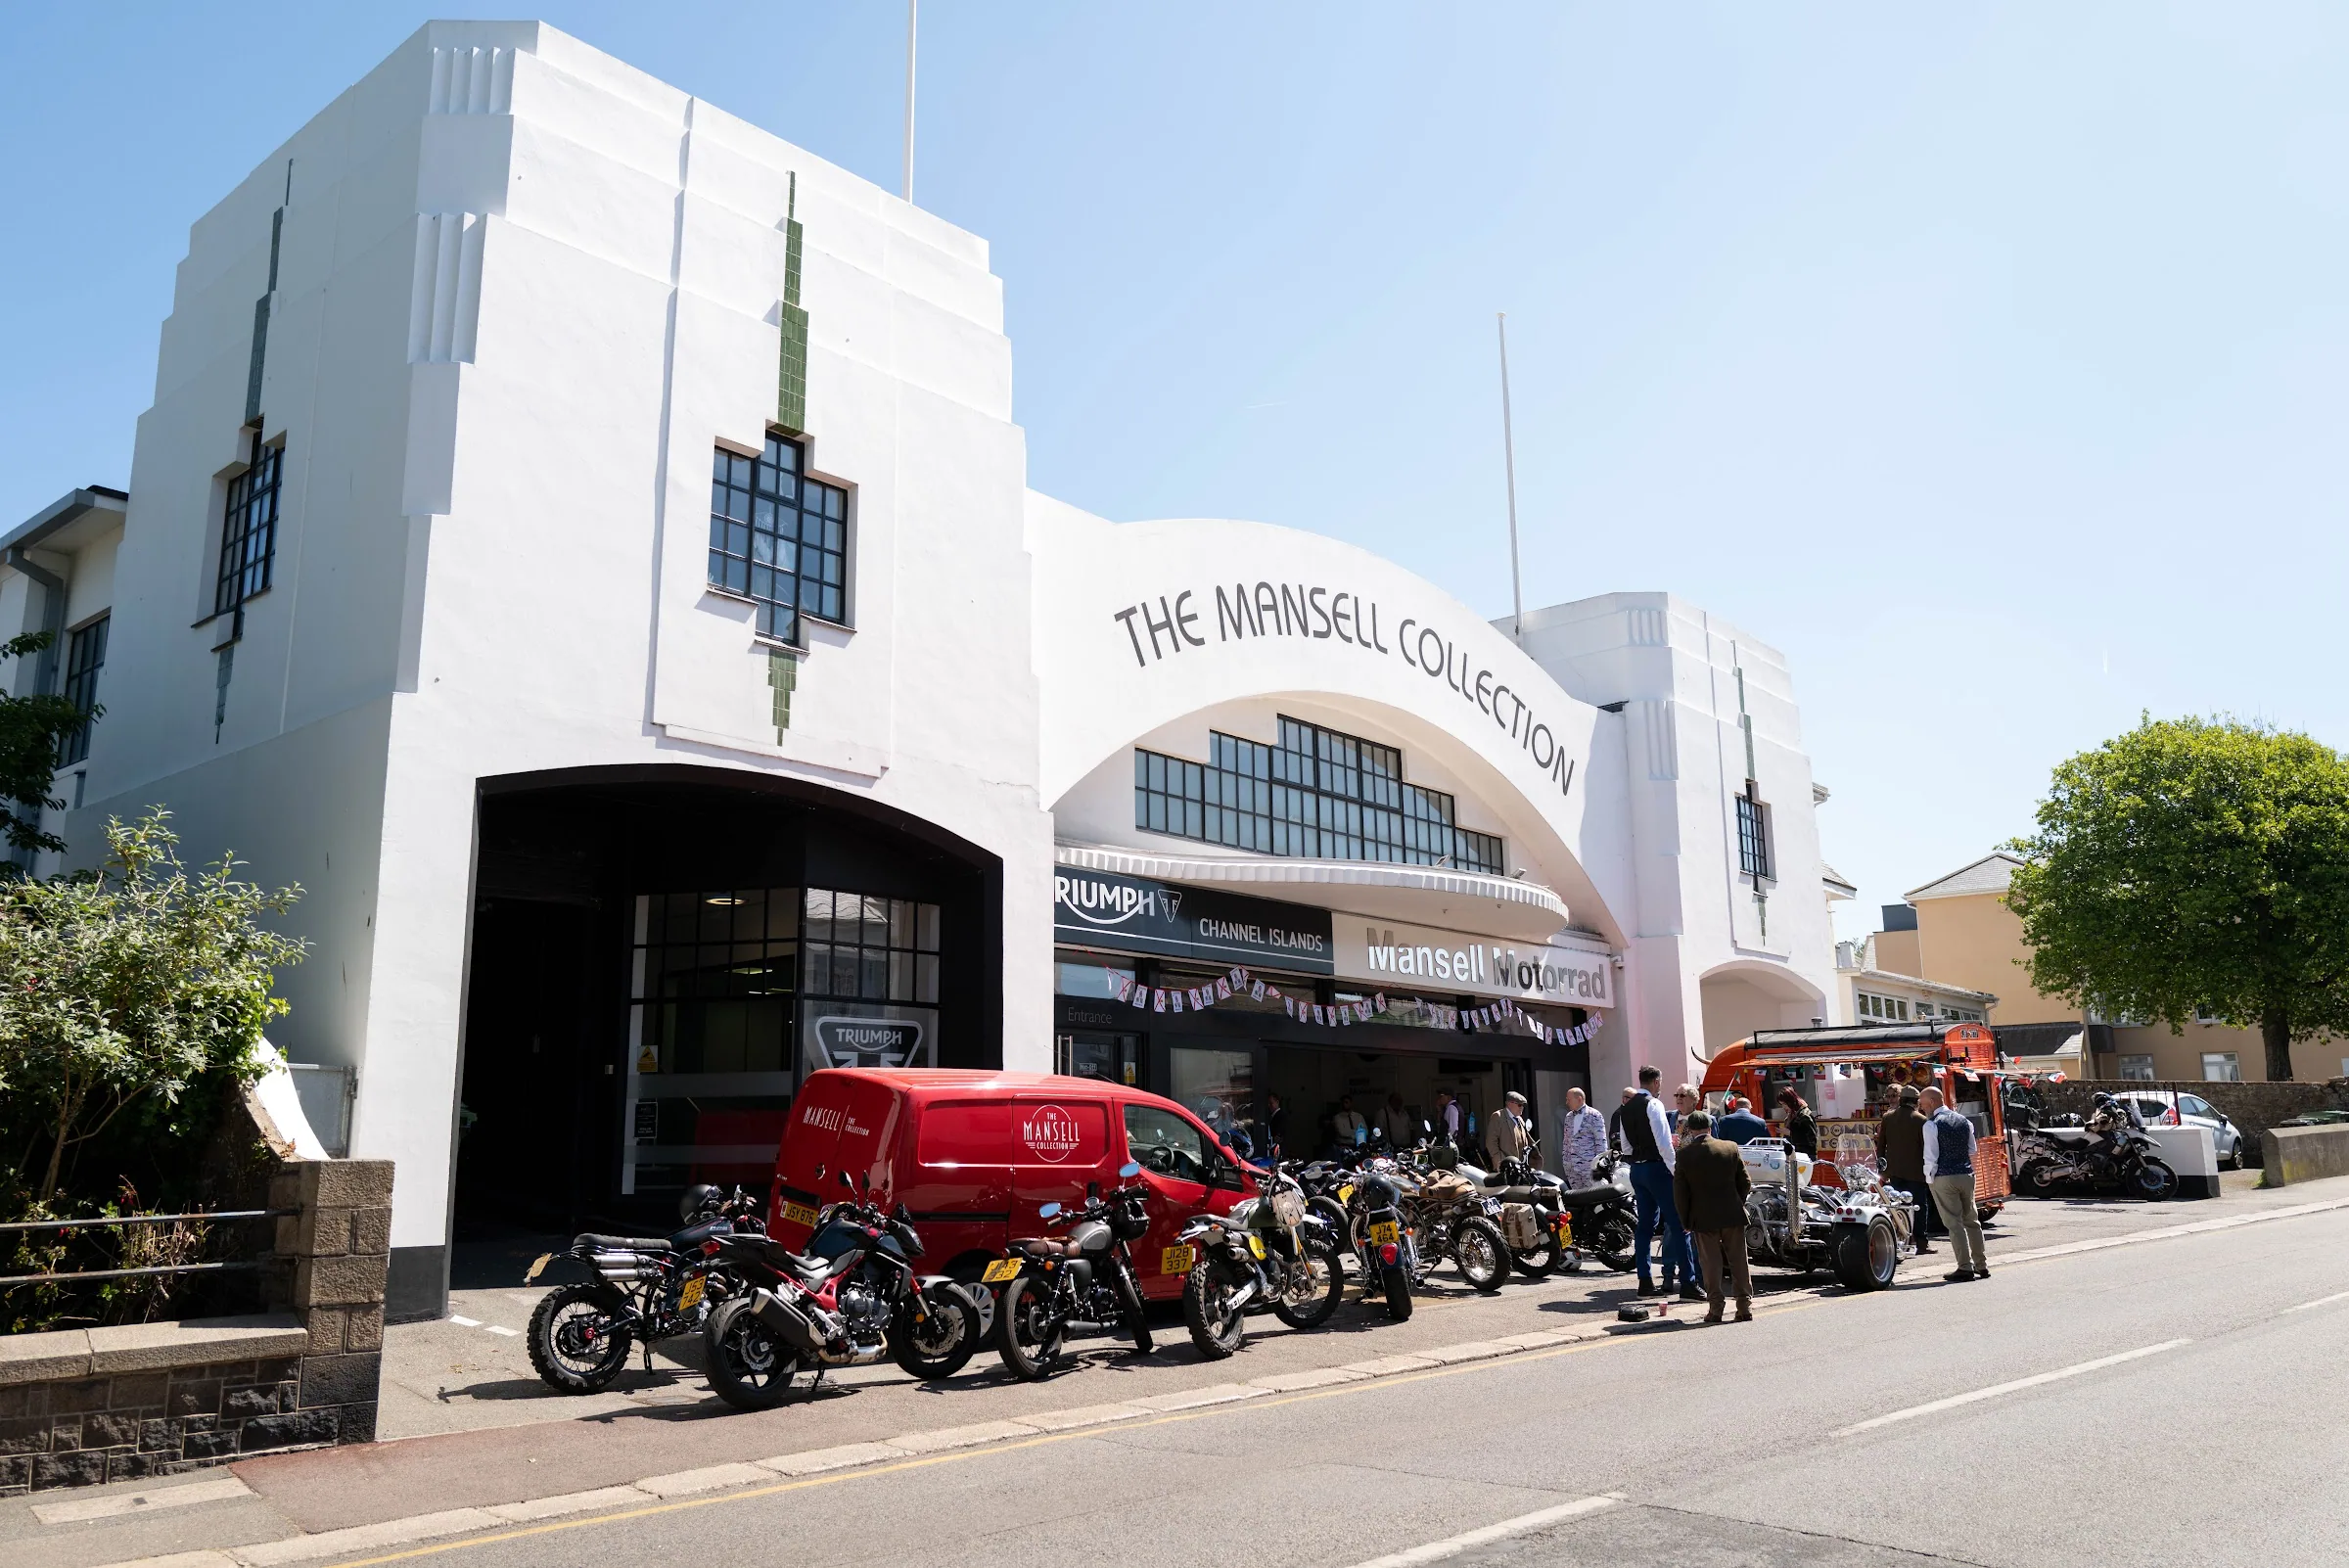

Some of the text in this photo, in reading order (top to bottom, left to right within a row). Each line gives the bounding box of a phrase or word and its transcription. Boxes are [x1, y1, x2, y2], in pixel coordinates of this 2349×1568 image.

[1115, 581, 1575, 797] THE MANSELL COLLECTION
[1055, 876, 1155, 924] RIUMPH
[1199, 917, 1322, 952] CHANNEL ISLANDS
[1366, 927, 1606, 999] Mansell Motorrad
[1068, 1006, 1113, 1025] Entrance
[836, 1028, 902, 1051] TRIUMPH
[803, 1105, 841, 1130] MANSELL
[1046, 1112, 1057, 1121] THE
[845, 1124, 870, 1136] COLLECTION
[1023, 1120, 1081, 1142] MANSELL
[1036, 1141, 1069, 1150] COLLECTION
[787, 1205, 814, 1224] JSY 876
[1376, 1224, 1392, 1235] J74
[1377, 1233, 1395, 1244] 464
[1166, 1246, 1189, 1260] J128
[1166, 1259, 1187, 1271] 337
[988, 1269, 1012, 1280] 332
[682, 1290, 701, 1308] 742
